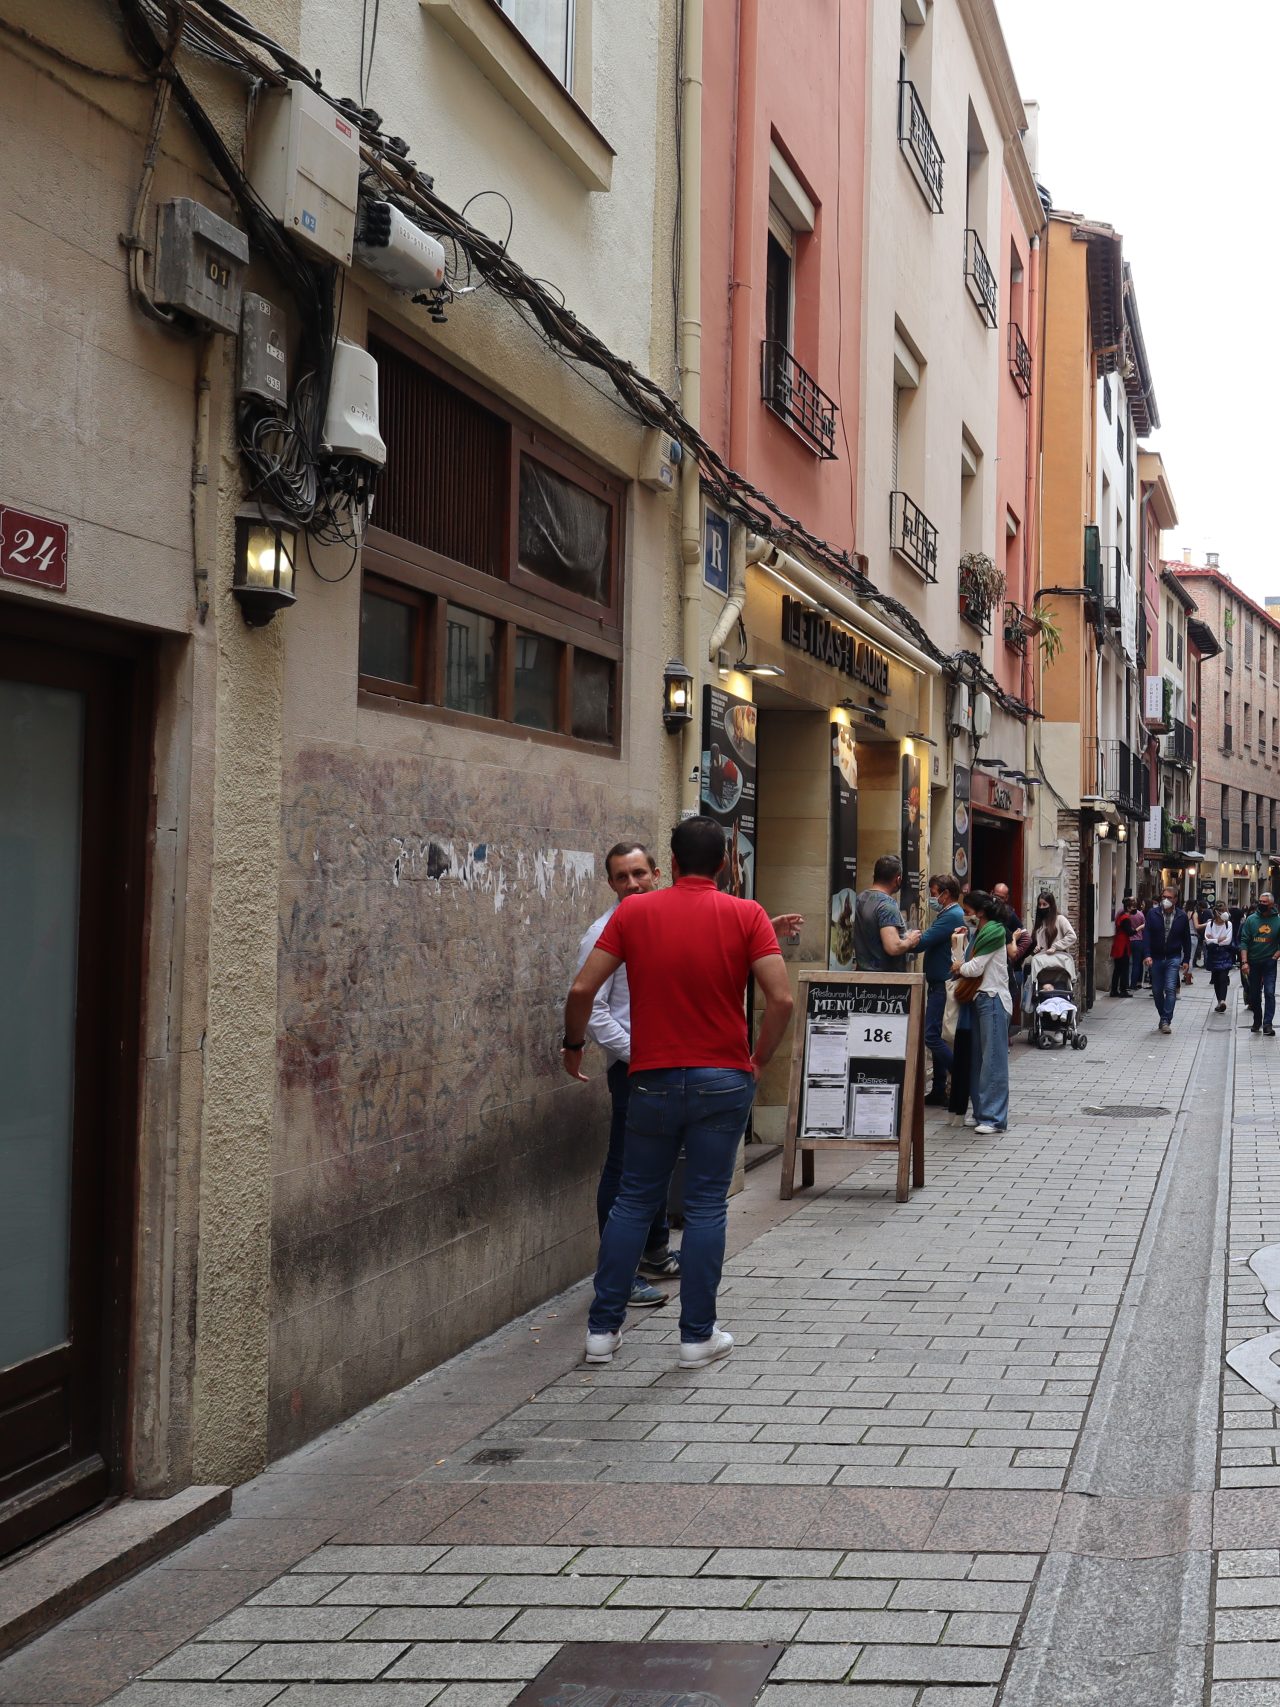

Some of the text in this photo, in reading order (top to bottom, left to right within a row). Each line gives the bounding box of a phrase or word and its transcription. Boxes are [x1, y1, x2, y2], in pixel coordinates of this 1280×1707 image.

[303, 213, 316, 229] 02
[209, 262, 229, 287] 01
[259, 302, 271, 314] 93
[8, 528, 57, 571] 24
[709, 528, 724, 573] R
[783, 595, 843, 668] LETRAS
[809, 985, 853, 1000] Restaurante
[813, 998, 905, 1014] MENÚ del DÍA
[863, 1028, 893, 1043] 18€
